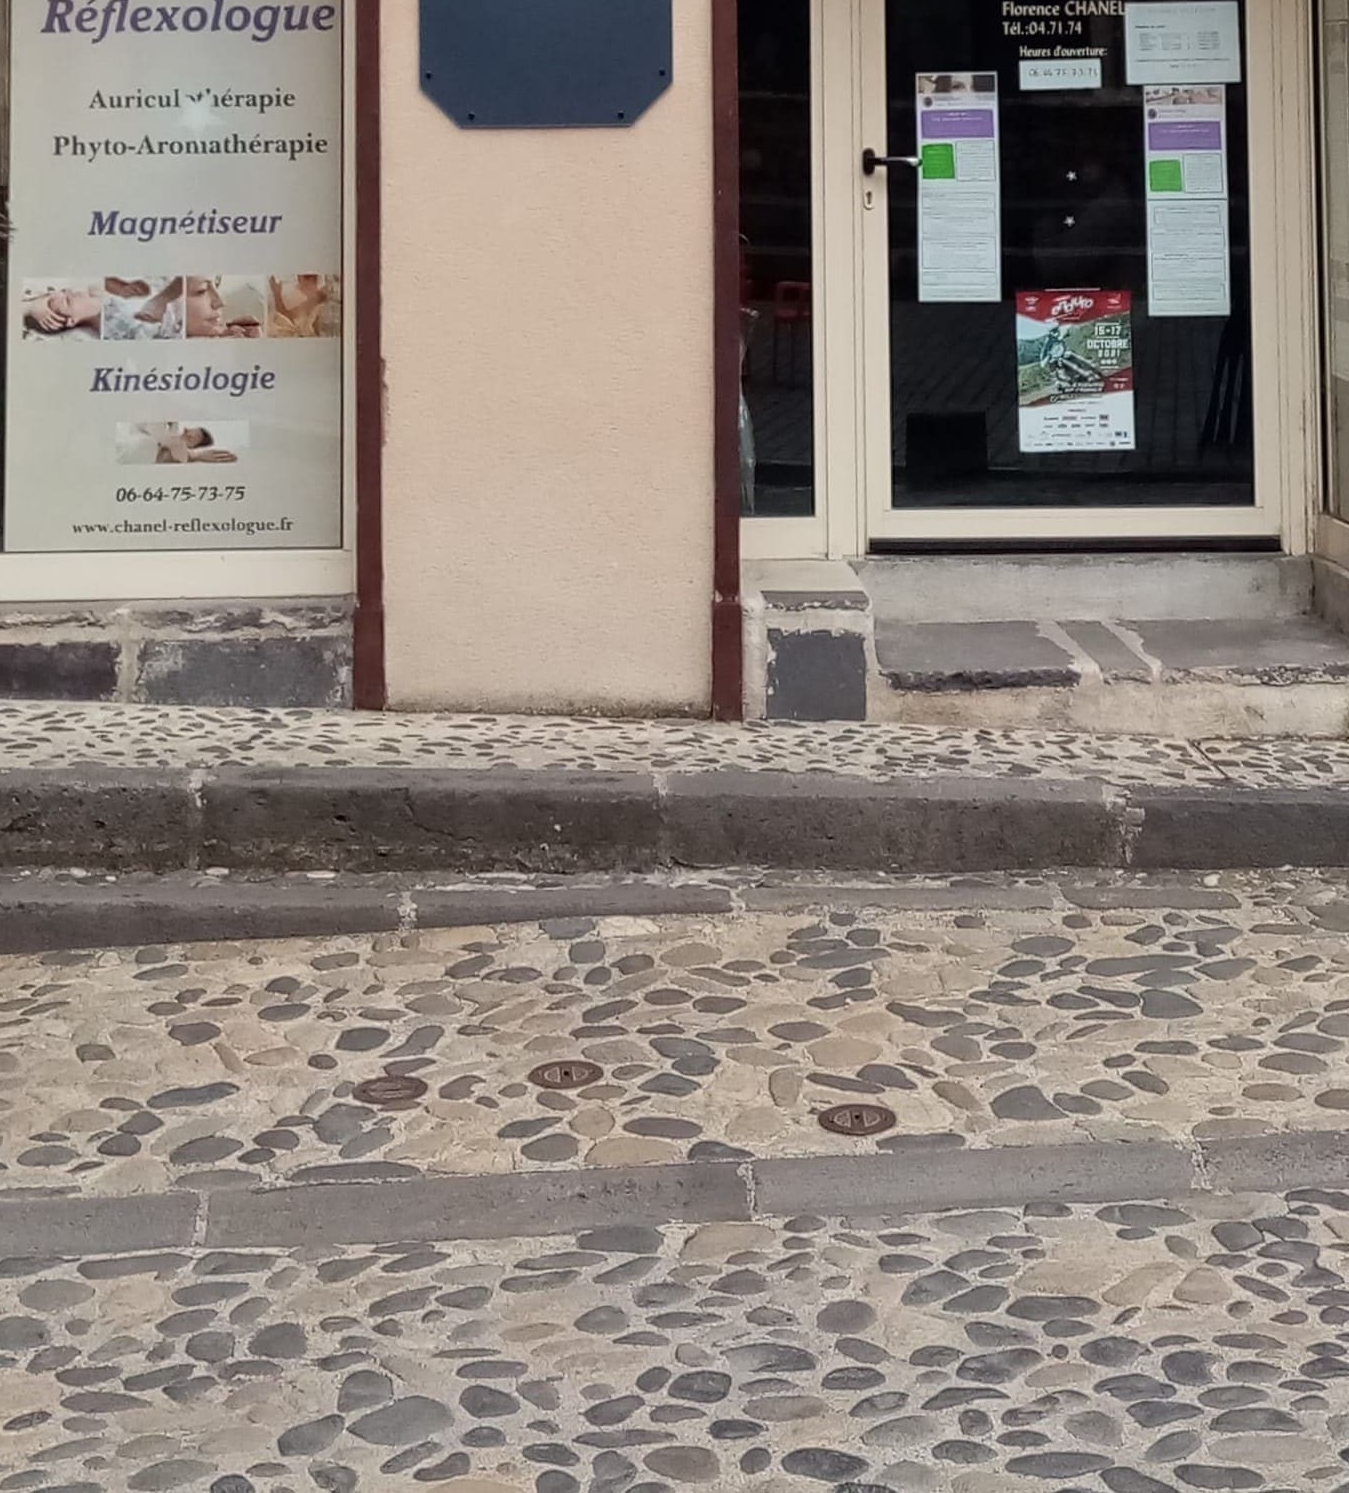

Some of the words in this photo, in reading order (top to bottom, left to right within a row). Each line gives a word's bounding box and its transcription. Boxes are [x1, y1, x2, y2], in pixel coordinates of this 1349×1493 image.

[1002, 0, 1060, 16] Florence
[1064, 0, 1126, 16] CHANEL
[1019, 45, 1051, 57] Heures
[53, 132, 329, 162] Phyto-Aromathérapie
[88, 209, 283, 242] Magnétiseur
[1086, 339, 1129, 349] OCTOBRE
[89, 364, 277, 398] Kinésiologie
[116, 485, 247, 503] 06-64-75-73-75
[72, 516, 295, 536] www.chanel-reflexologue.fr
